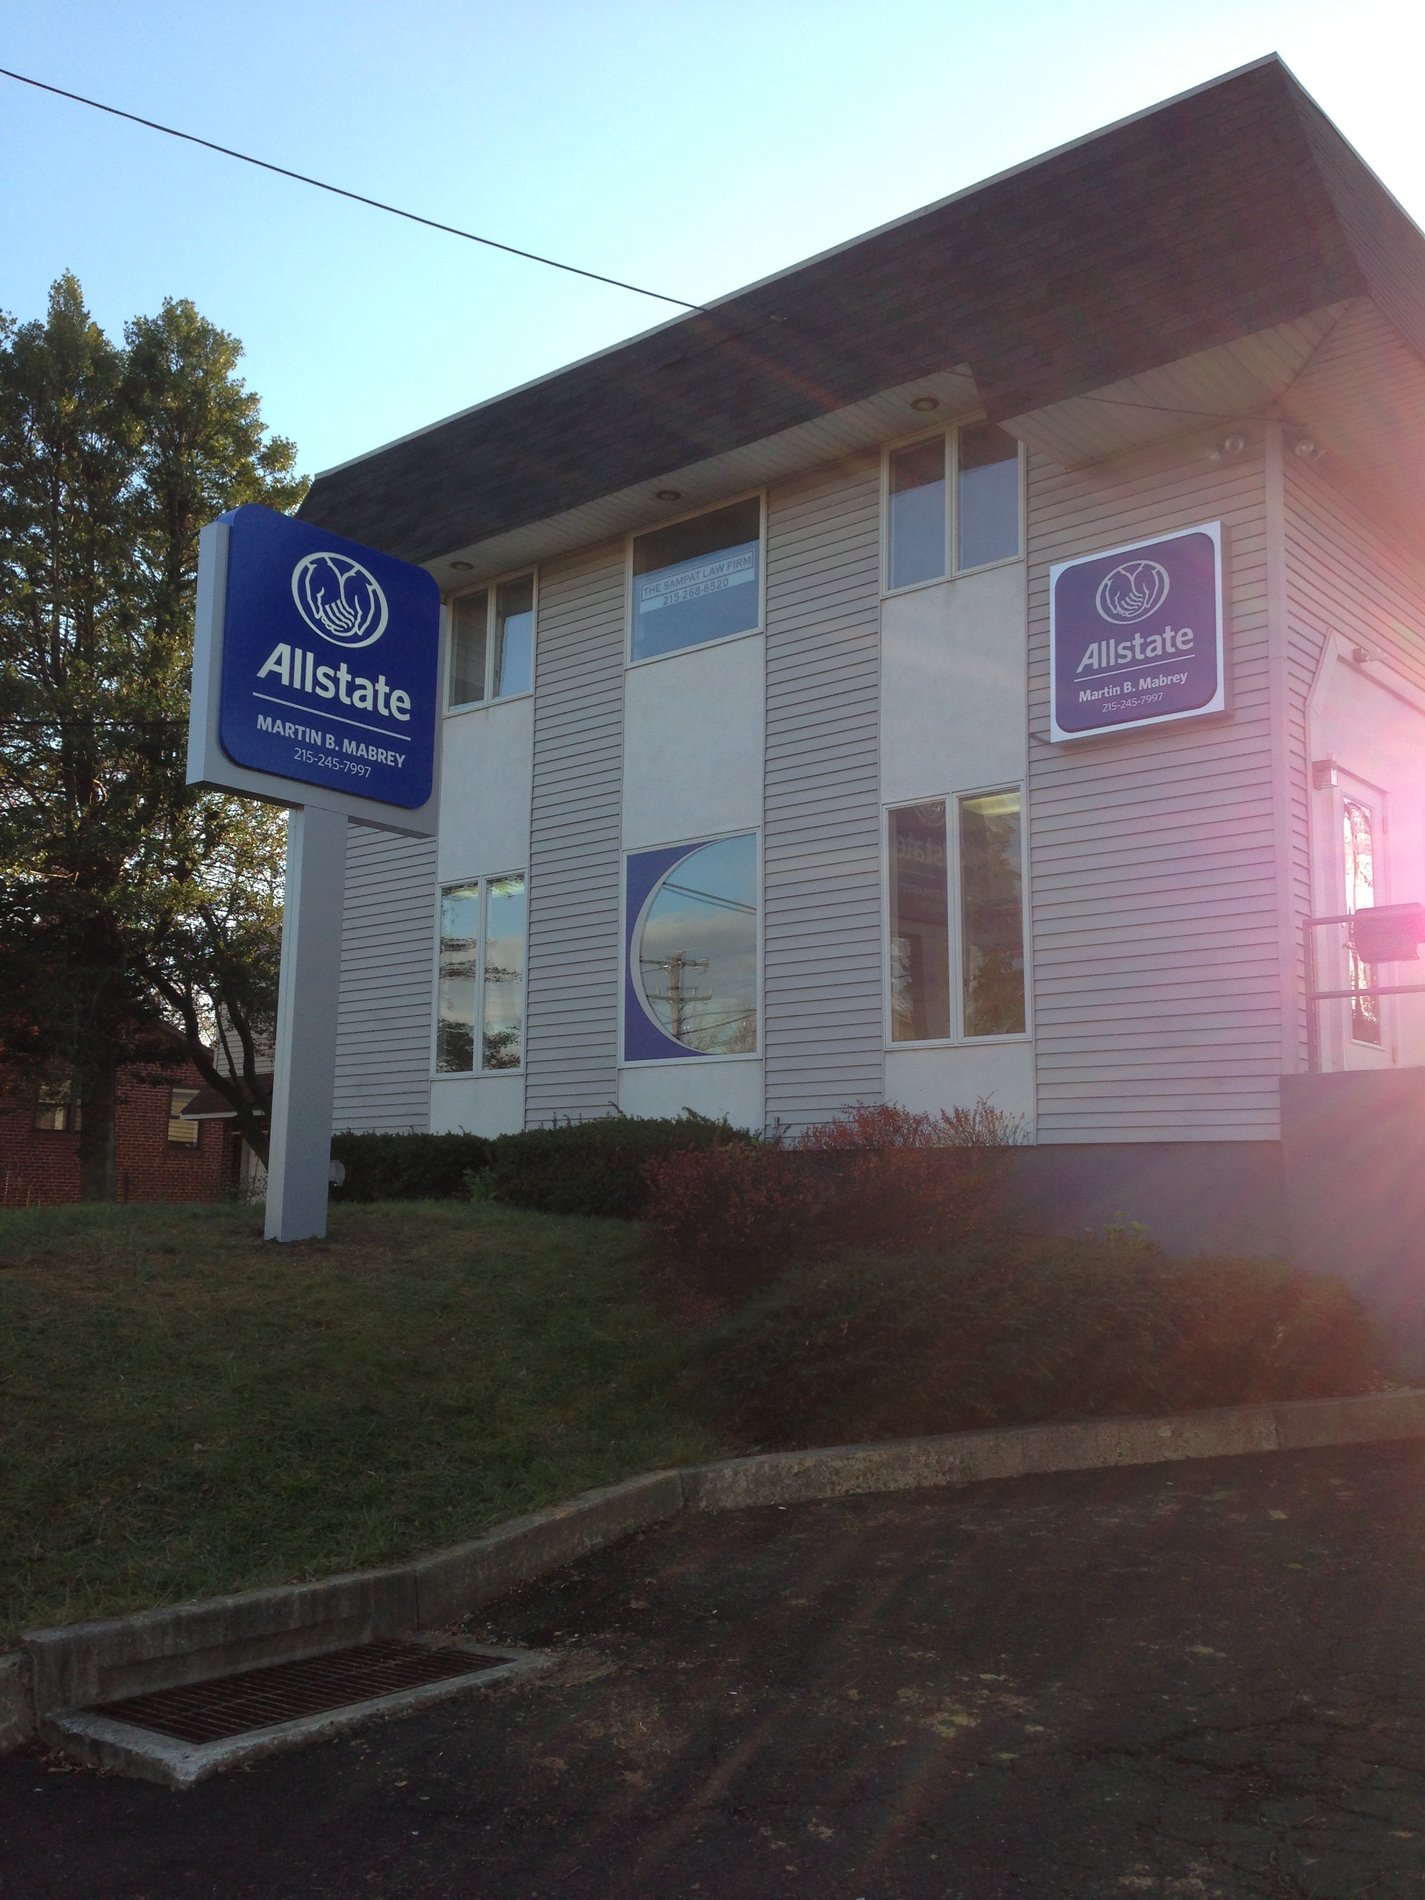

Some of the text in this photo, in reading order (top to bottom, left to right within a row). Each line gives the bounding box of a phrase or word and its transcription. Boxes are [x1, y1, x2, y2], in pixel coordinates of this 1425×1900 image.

[644, 557, 751, 595] THE SAMPAT LAW FIRM
[1076, 625, 1194, 673] Allstate
[257, 643, 411, 720] Allstate
[1079, 672, 1188, 702] Martin B. Mabrey
[1102, 693, 1163, 712] 215-245-7997
[257, 714, 405, 768] MARTIN B. MABREY
[294, 747, 372, 778] 215-245-7997
